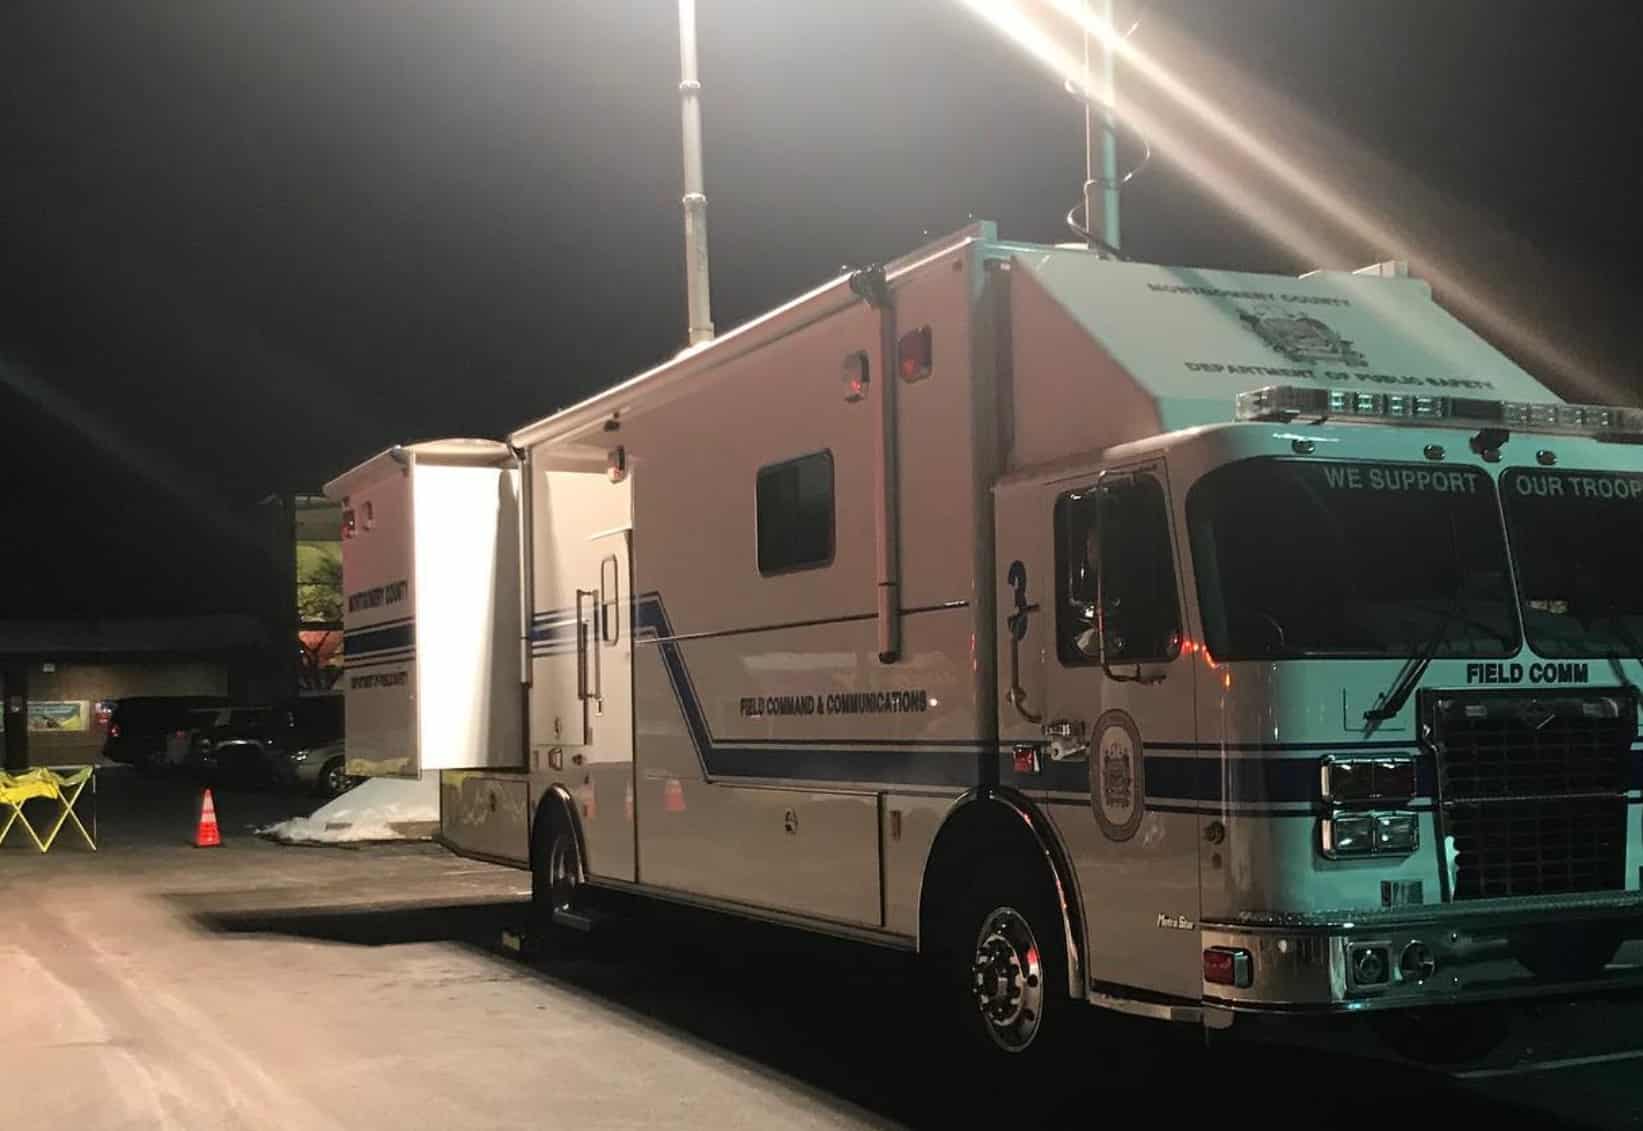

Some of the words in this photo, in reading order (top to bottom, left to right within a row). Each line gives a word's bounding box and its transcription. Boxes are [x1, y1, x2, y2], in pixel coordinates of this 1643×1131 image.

[1186, 361, 1313, 377] DEPARTMENT
[1325, 370, 1350, 381] OF
[1325, 467, 1362, 488] WE
[1370, 469, 1478, 492] SUPPORT
[1516, 476, 1563, 496] OUR
[1467, 663, 1523, 684] FIELD
[1529, 663, 1588, 684] COMM
[740, 696, 764, 717] FIELD
[766, 695, 815, 715] COMMAND
[817, 695, 825, 714] &
[826, 689, 927, 713] COMMUNICATIONS
